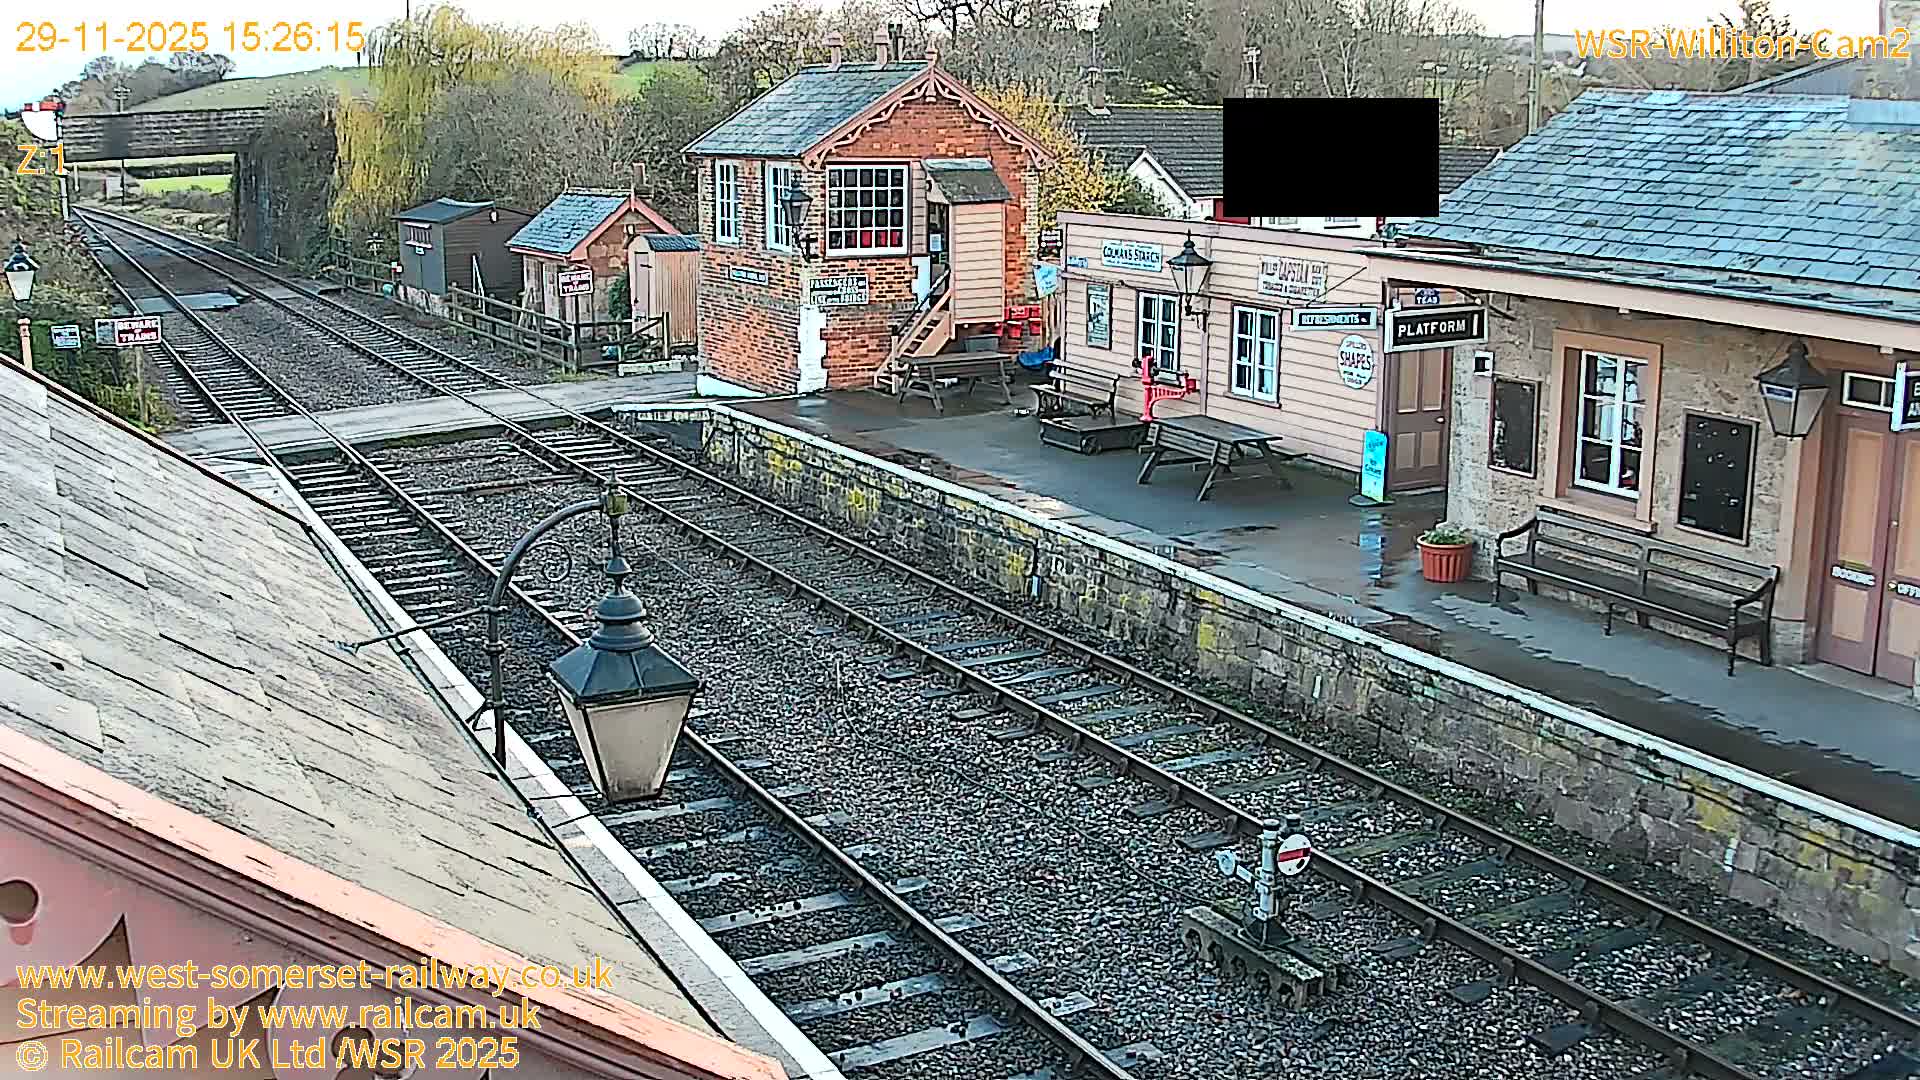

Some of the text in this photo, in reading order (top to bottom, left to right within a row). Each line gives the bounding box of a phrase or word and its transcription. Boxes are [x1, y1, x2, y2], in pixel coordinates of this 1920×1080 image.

[117, 320, 160, 331] BEWARE
[1301, 314, 1360, 325] REFRESHMENTS
[1397, 319, 1466, 338] PLATFORM
[119, 331, 158, 343] TRAINS
[1339, 350, 1371, 371] SHAPES
